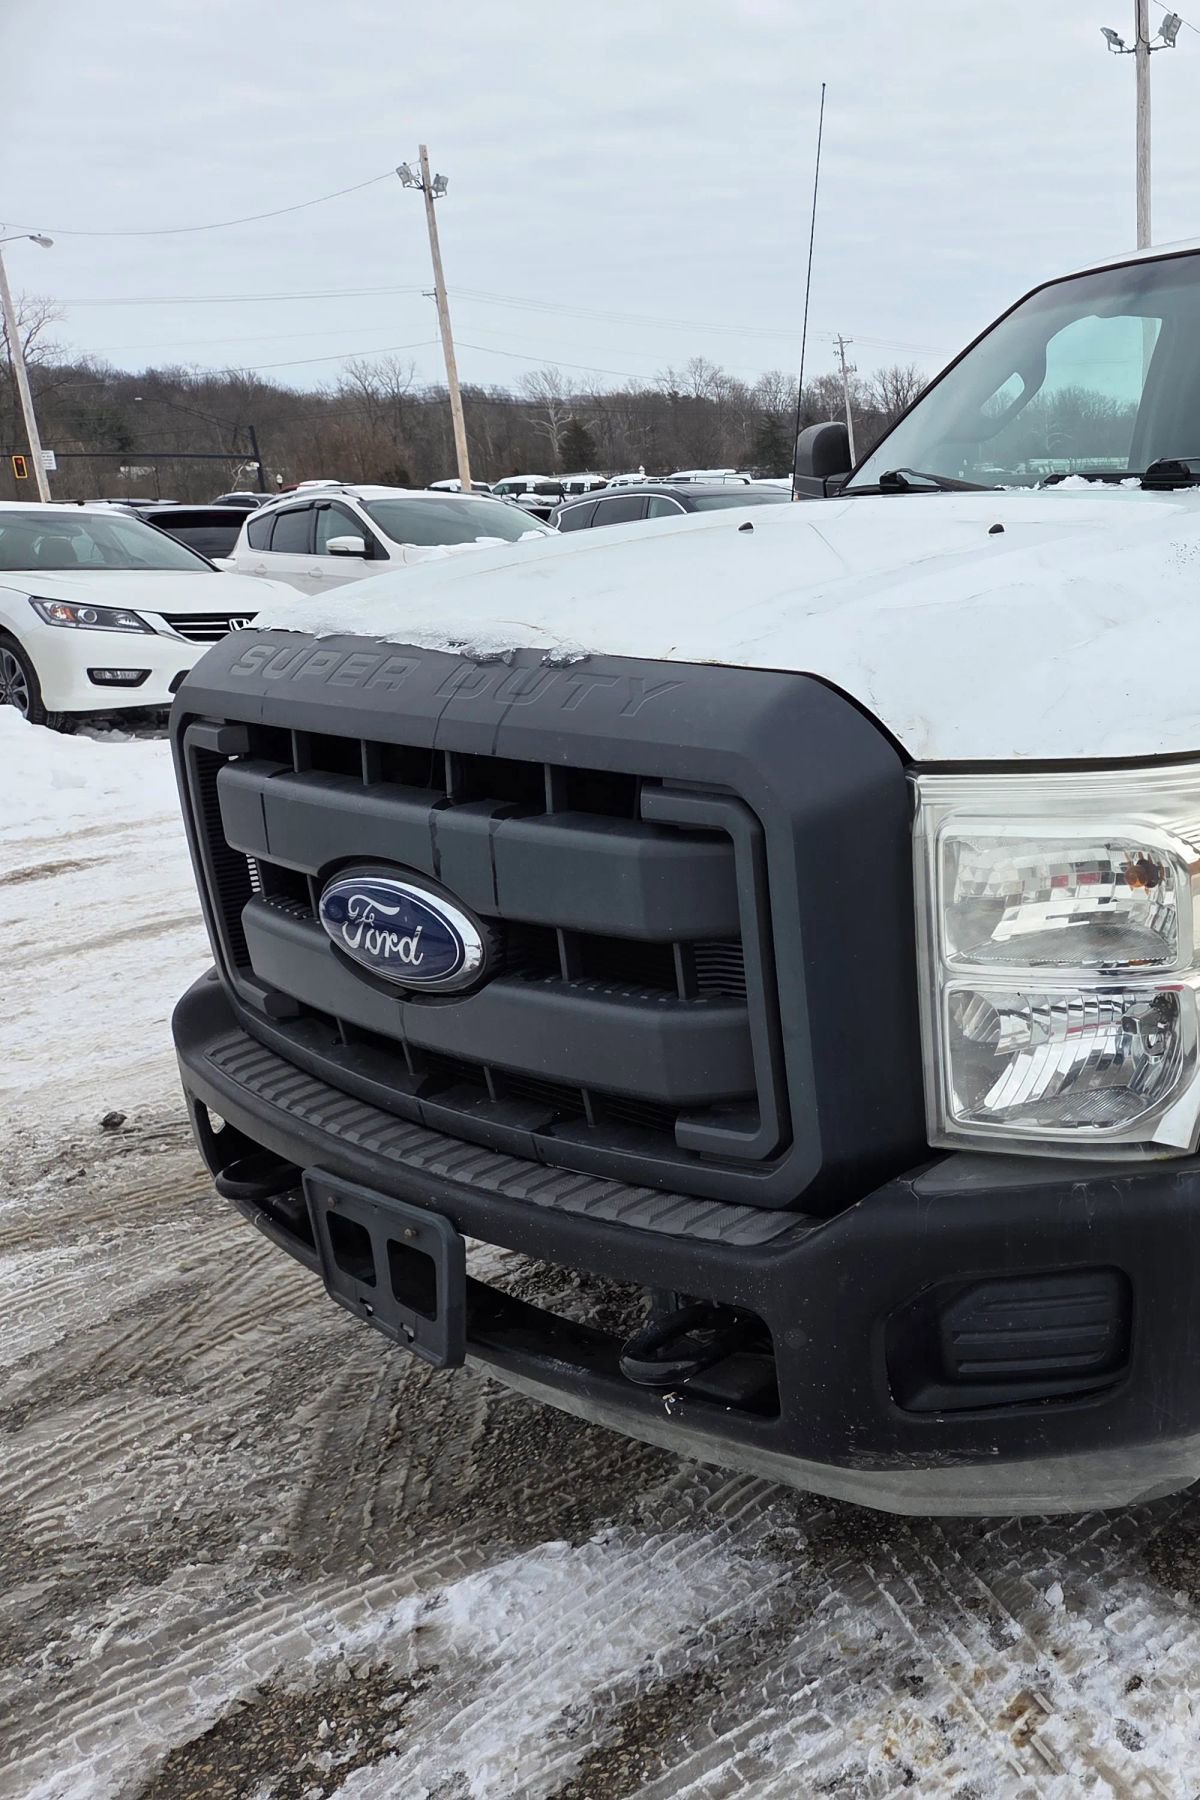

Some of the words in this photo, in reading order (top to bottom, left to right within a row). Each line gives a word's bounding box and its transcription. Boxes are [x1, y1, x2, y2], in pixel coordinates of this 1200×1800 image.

[230, 643, 422, 693] SUPER
[433, 661, 686, 718] DUTY
[341, 893, 424, 966] Ford
